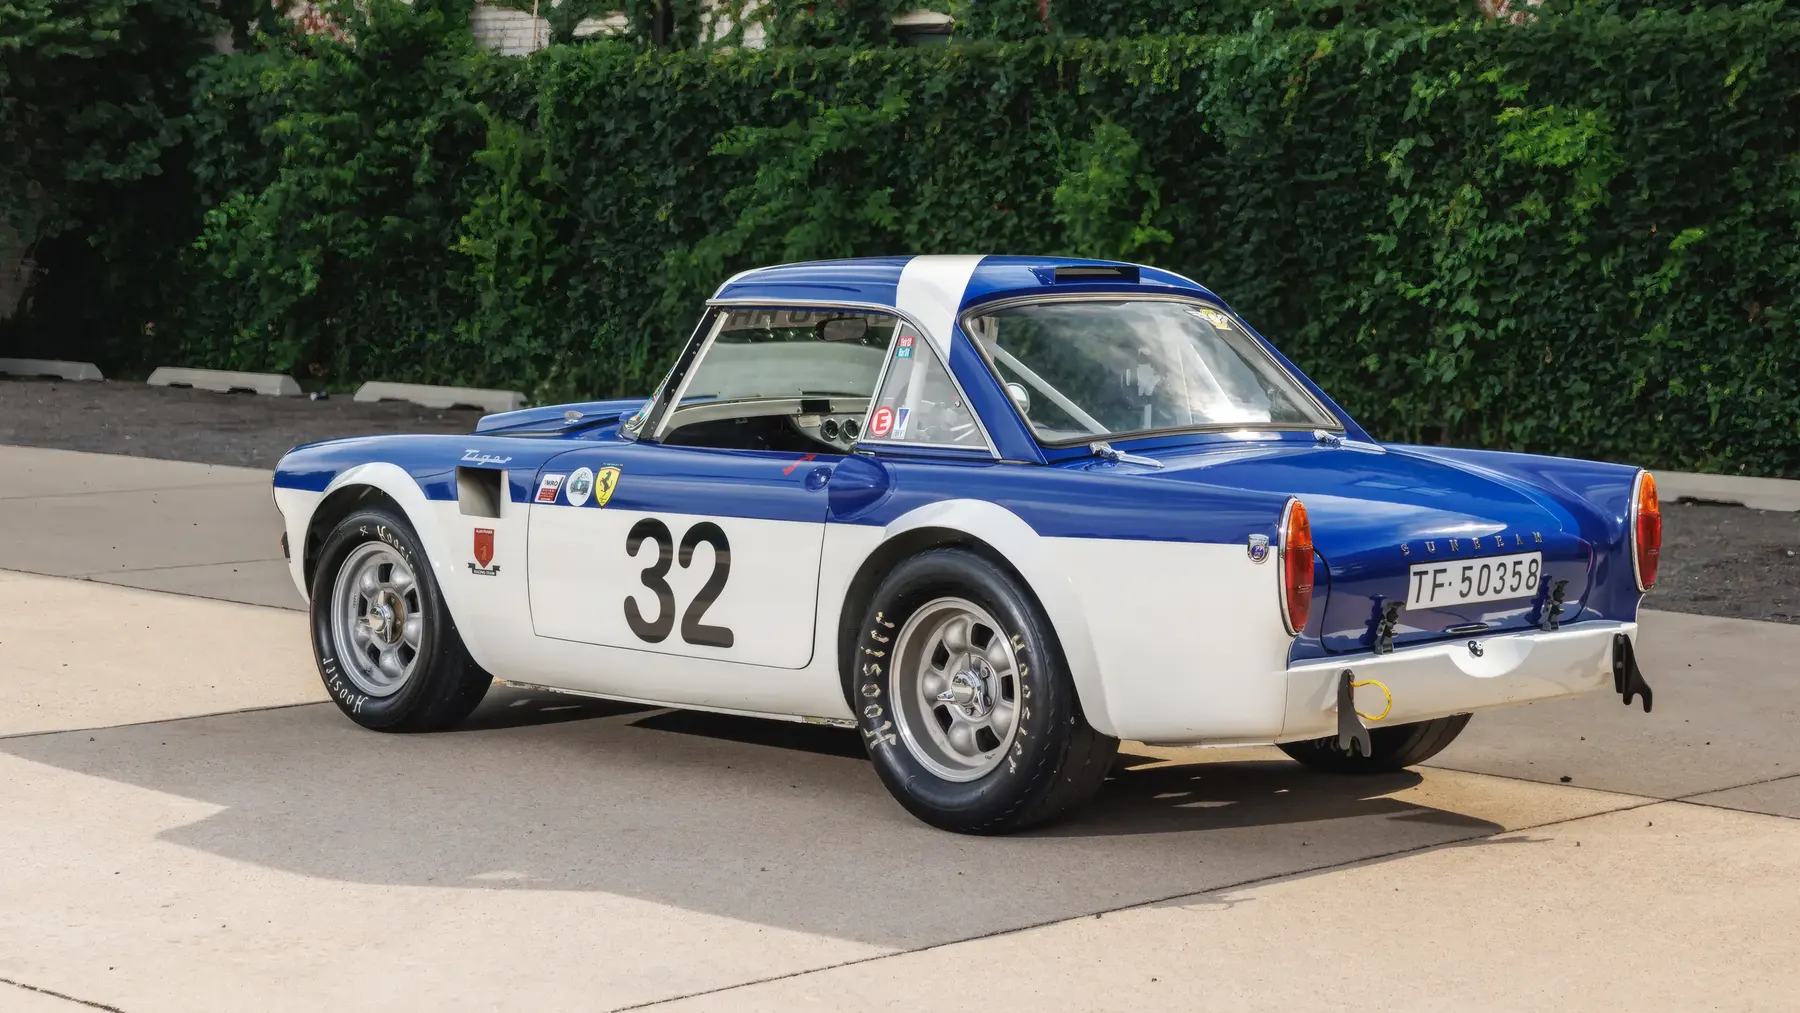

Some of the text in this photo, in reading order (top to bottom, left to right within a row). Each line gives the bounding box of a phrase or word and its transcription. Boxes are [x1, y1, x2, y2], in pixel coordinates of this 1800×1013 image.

[461, 449, 512, 465] Tiger
[1401, 531, 1543, 556] SUNBEAM
[624, 517, 734, 648] 32
[322, 657, 369, 714] Hoosier
[860, 612, 897, 750] Hoosier
